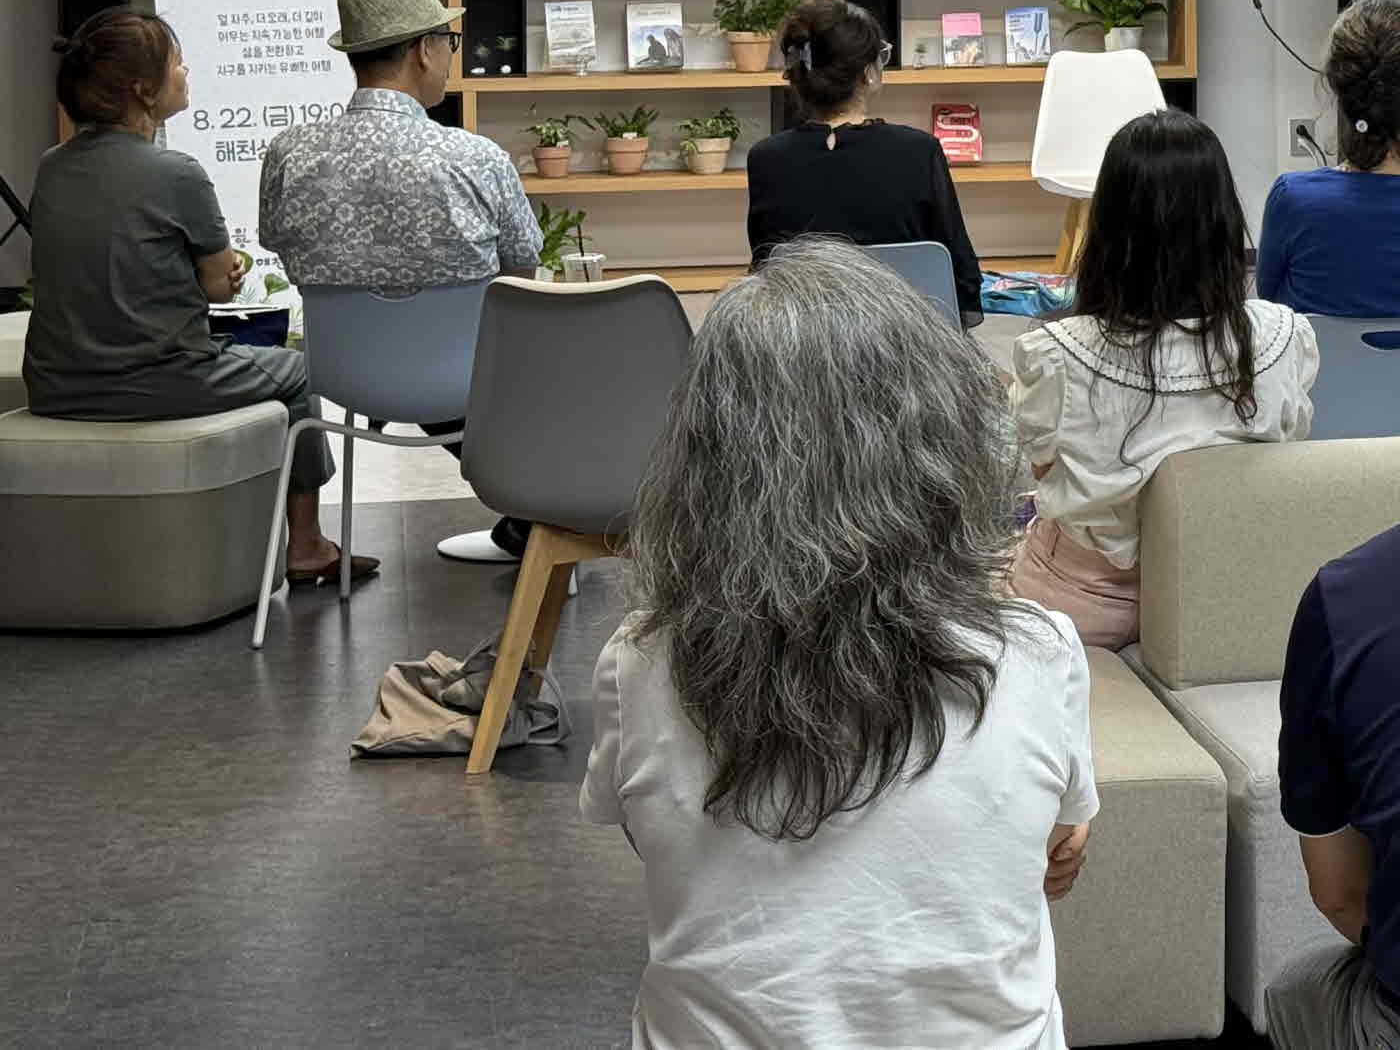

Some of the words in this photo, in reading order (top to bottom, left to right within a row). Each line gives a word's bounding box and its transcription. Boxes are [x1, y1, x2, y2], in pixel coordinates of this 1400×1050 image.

[193, 109, 215, 131] 8.
[219, 107, 257, 128] 22.
[263, 105, 295, 127] (금)
